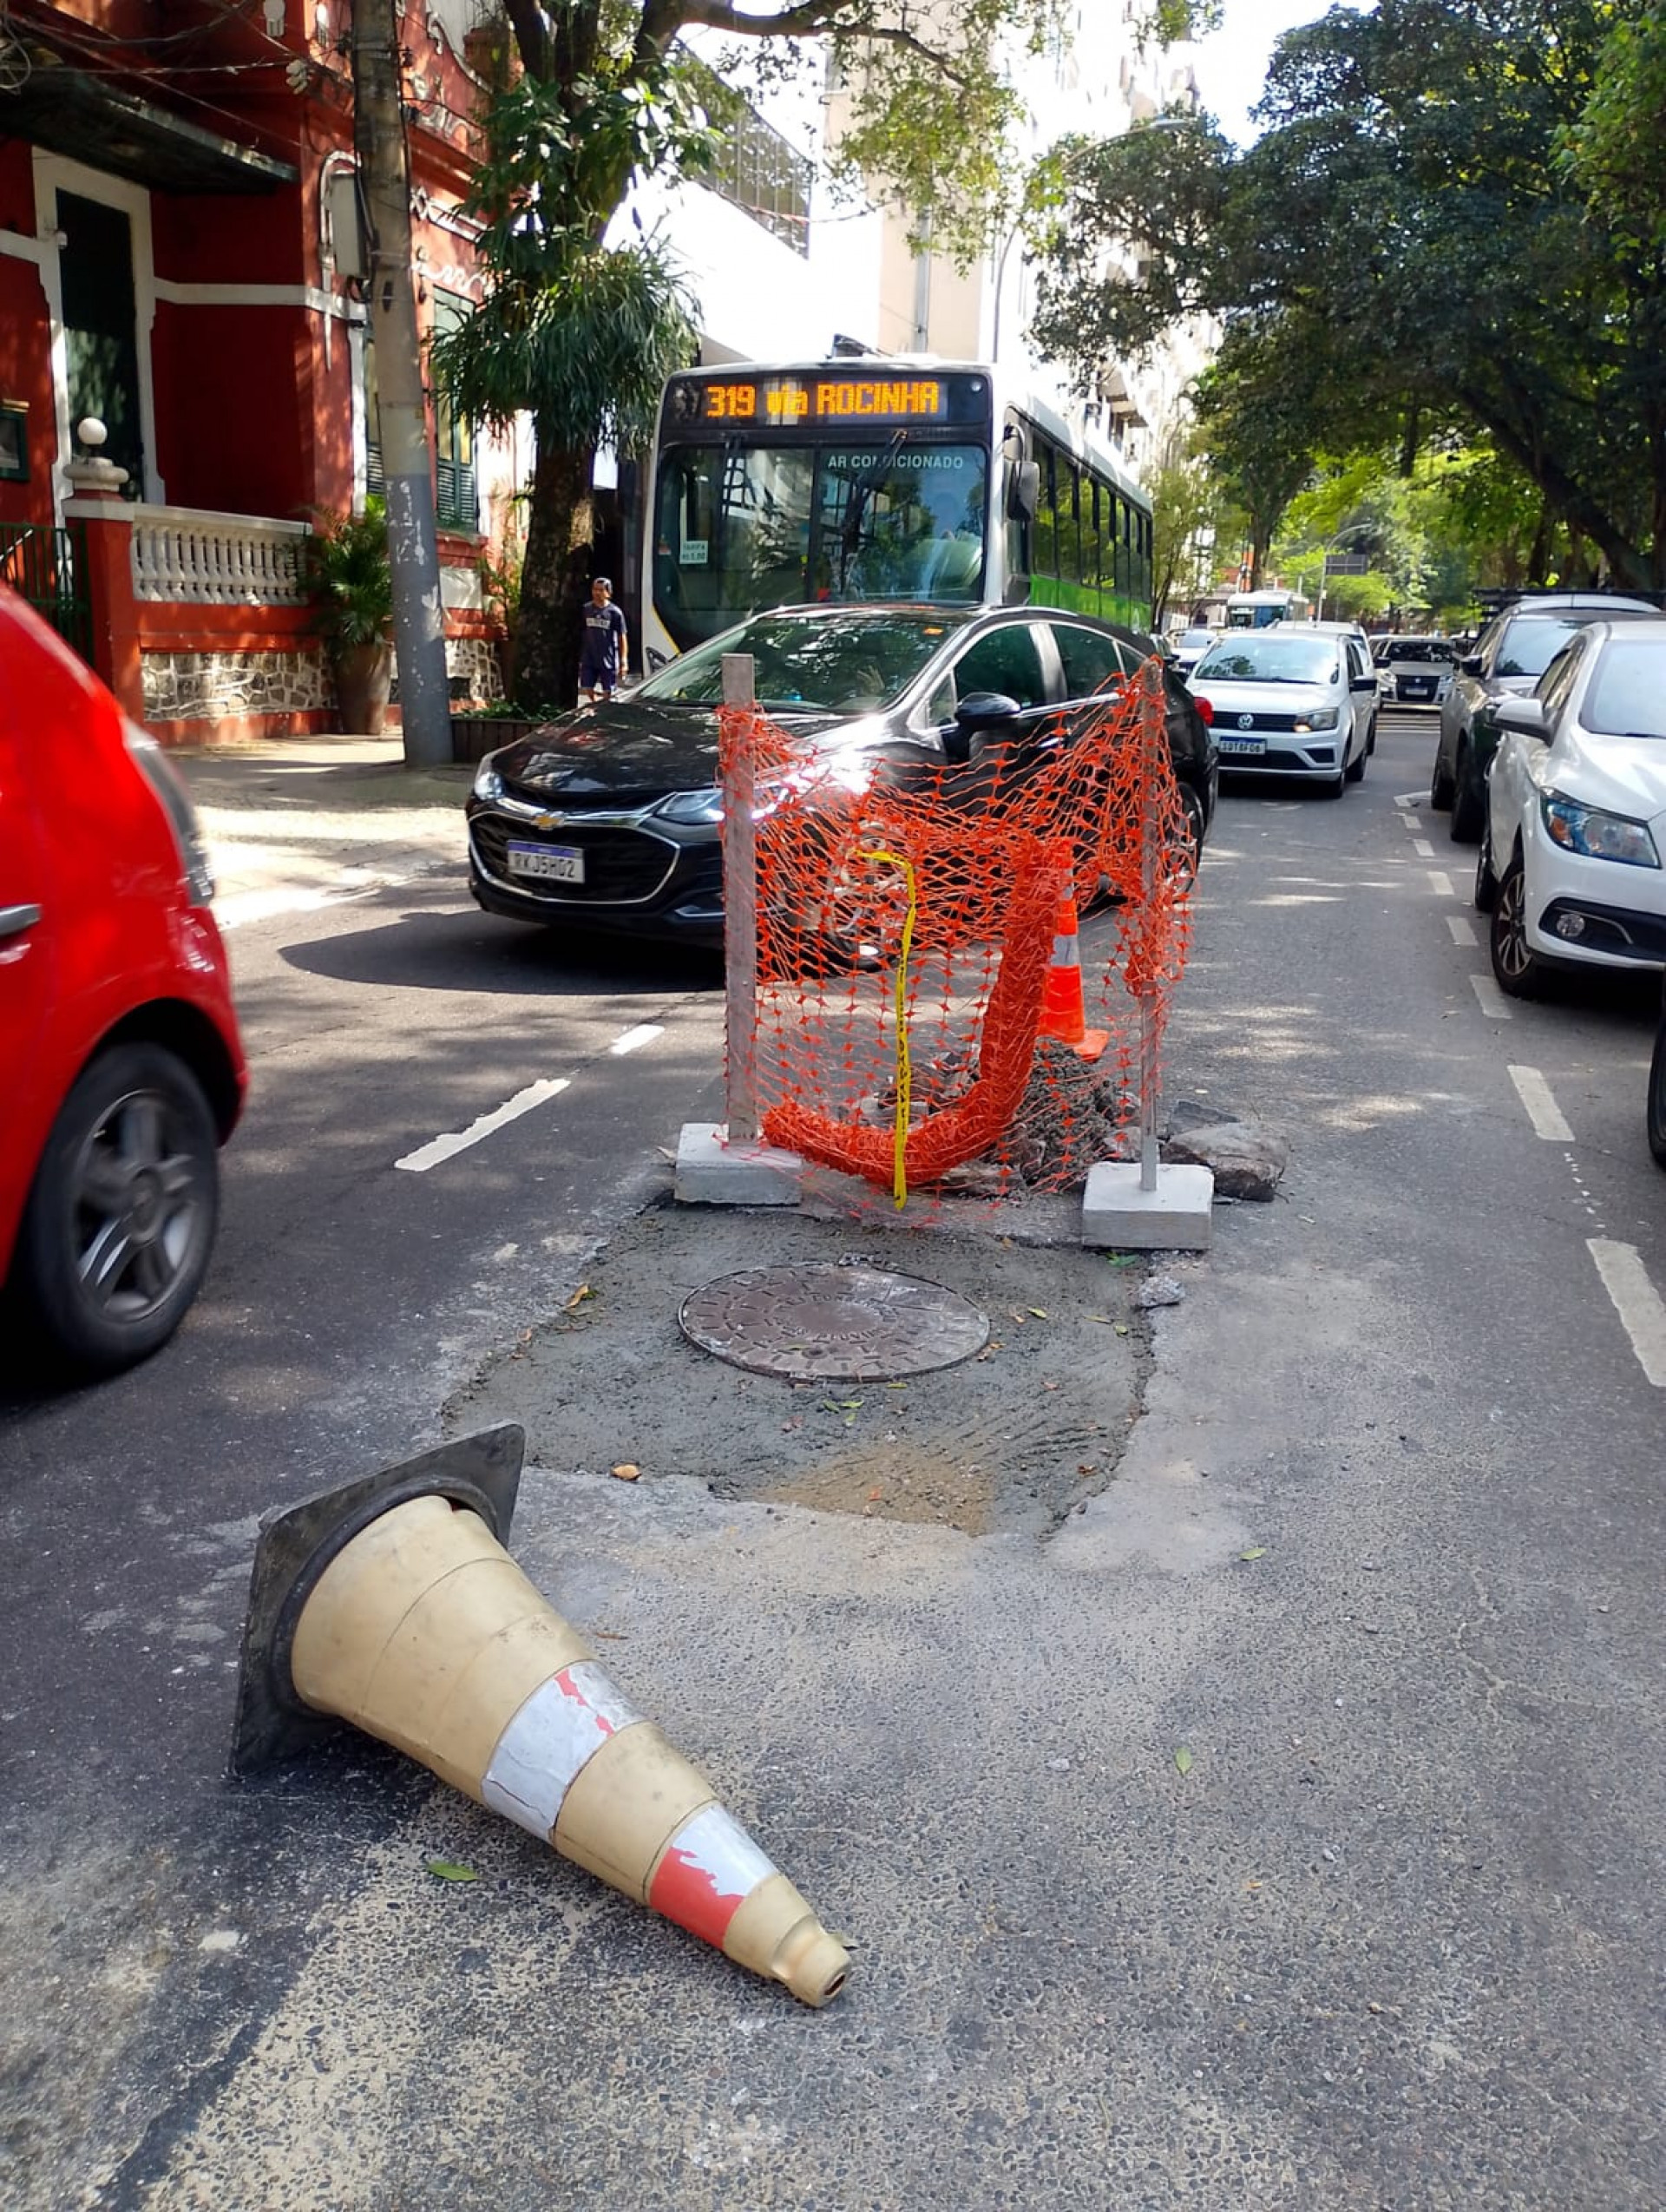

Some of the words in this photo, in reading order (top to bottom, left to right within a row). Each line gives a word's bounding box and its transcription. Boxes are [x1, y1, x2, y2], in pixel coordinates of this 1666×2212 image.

[707, 386, 756, 417] 319
[767, 384, 808, 415] via
[817, 382, 939, 414] ROCINHA
[828, 455, 847, 468] AR
